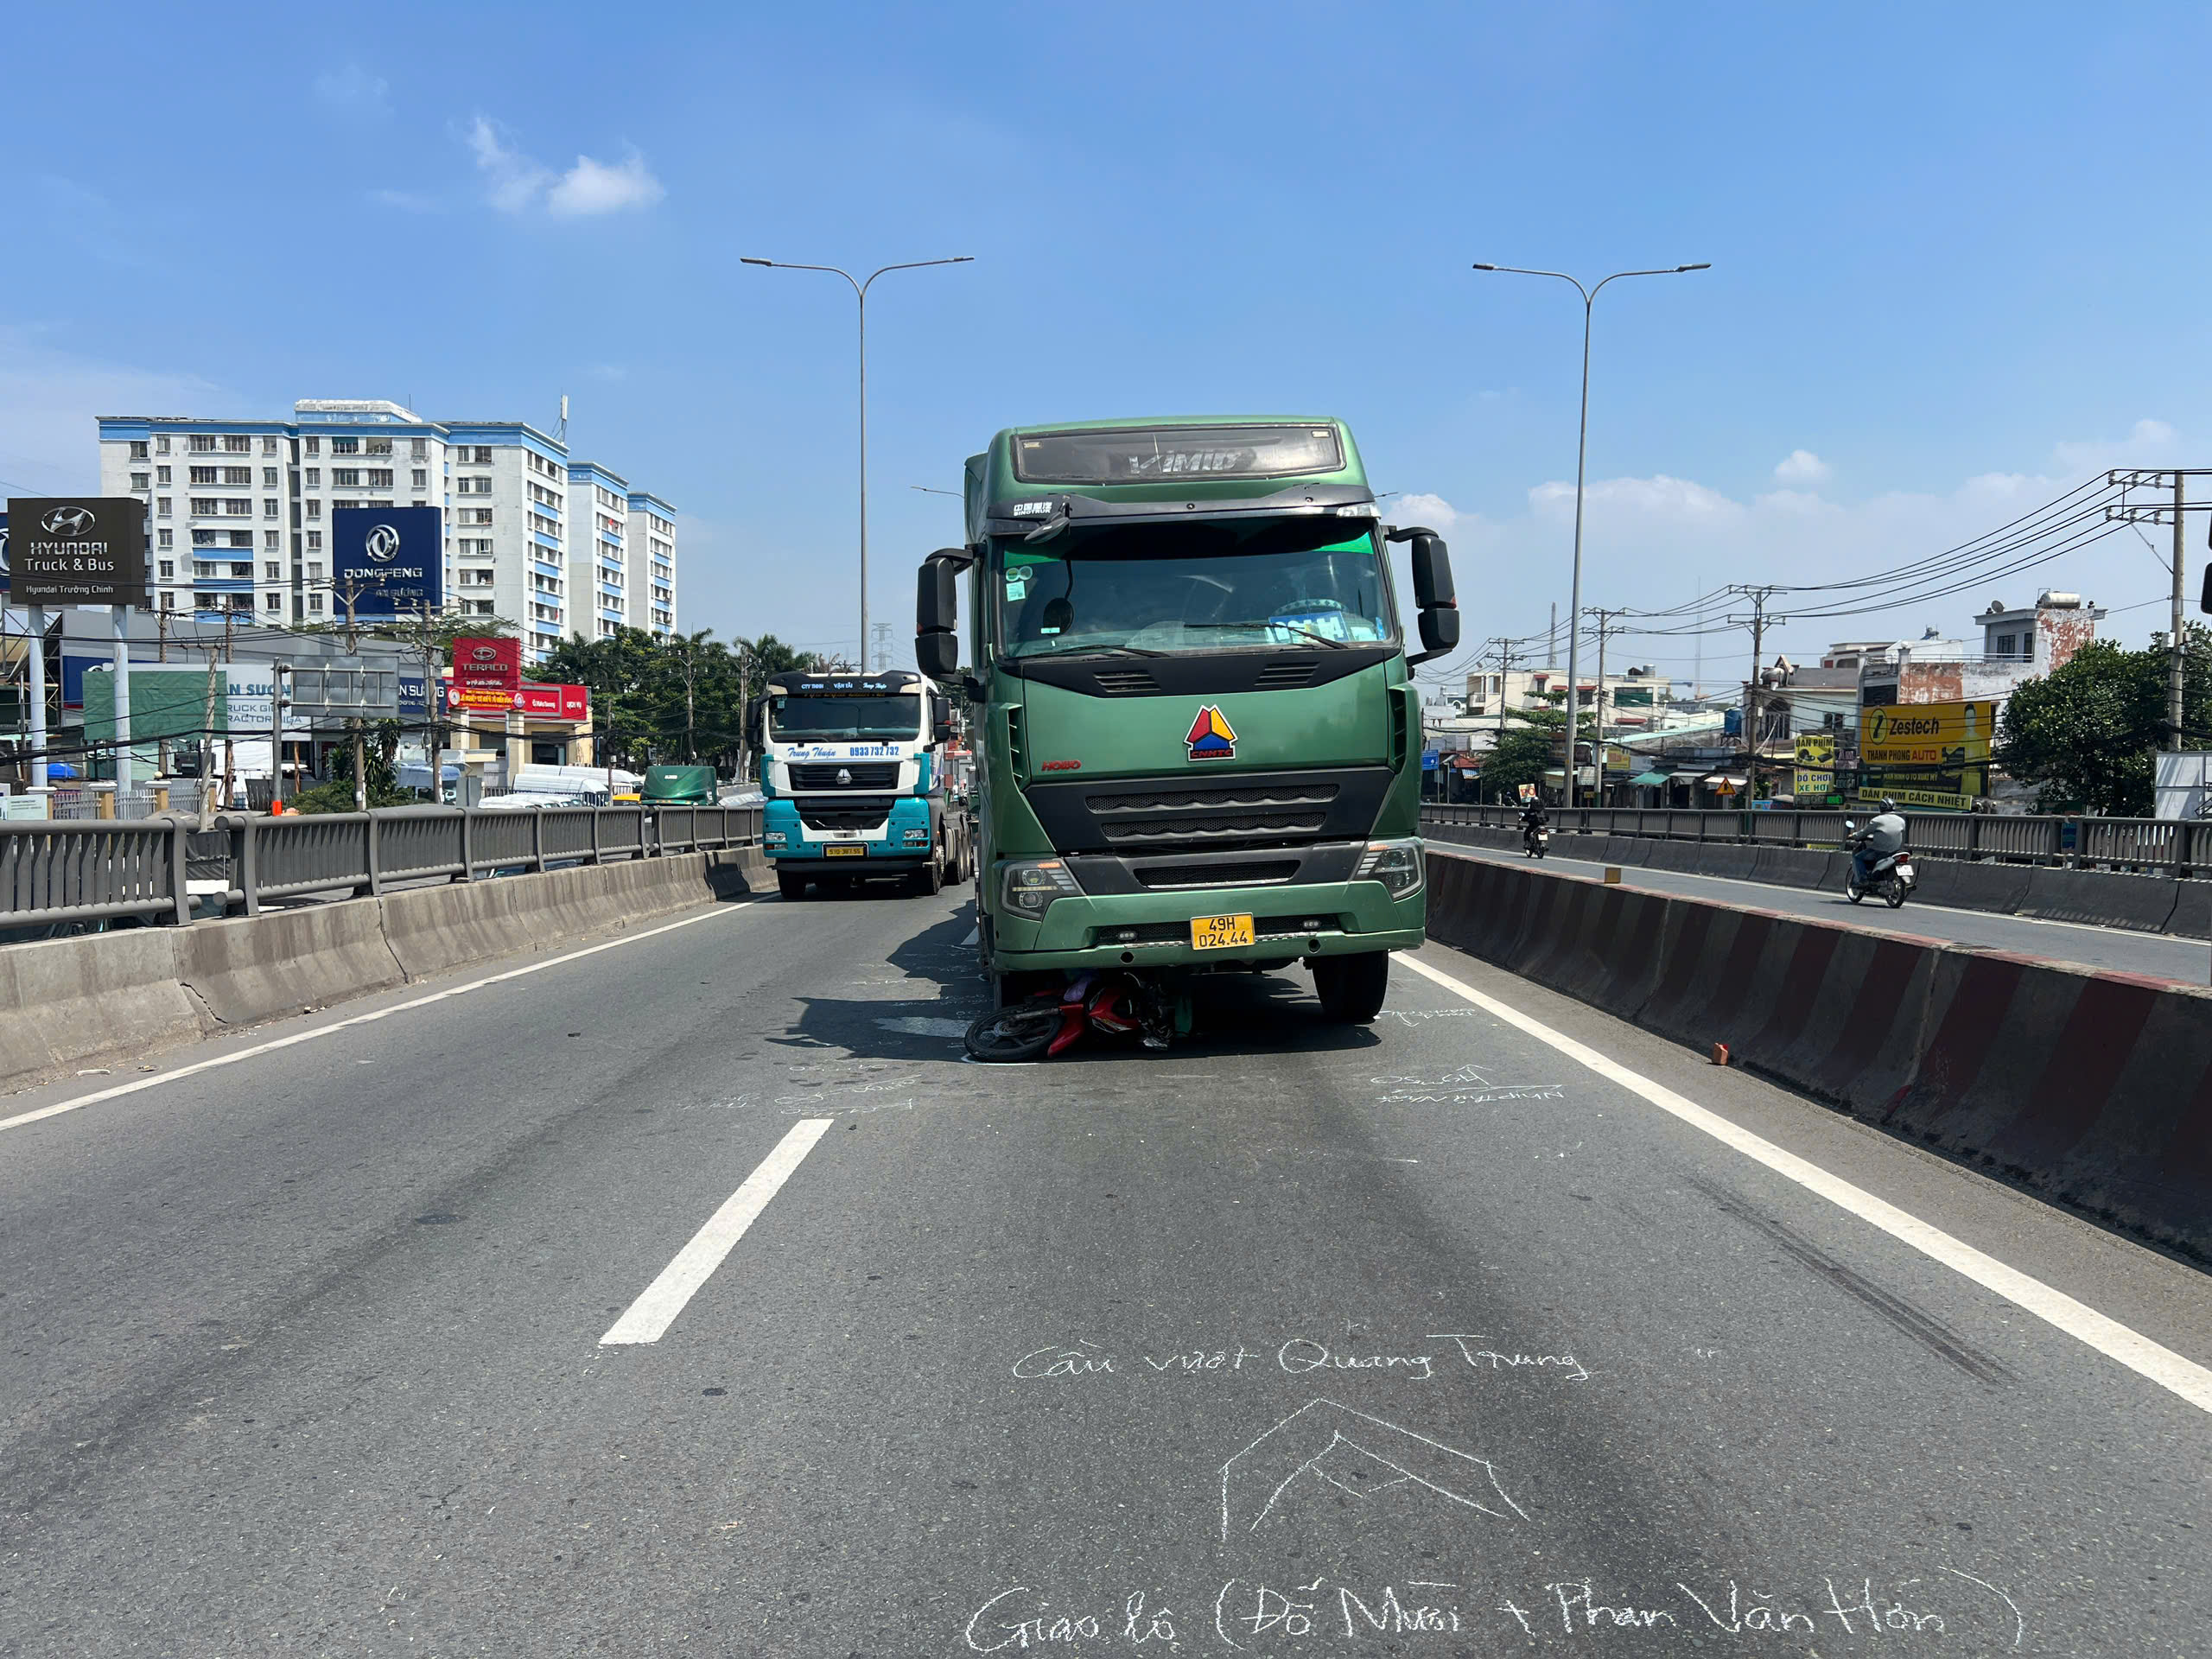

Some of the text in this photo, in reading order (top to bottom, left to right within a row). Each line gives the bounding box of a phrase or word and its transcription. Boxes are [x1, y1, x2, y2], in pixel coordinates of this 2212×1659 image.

[30, 542, 108, 555] HYUNDAI
[24, 558, 114, 571] Truck & Bus
[344, 568, 423, 578] DONGFENG
[26, 585, 57, 594] Hyundai
[92, 585, 114, 594] Chinh
[1889, 716, 1939, 734] Zestech
[787, 747, 810, 760] Trung
[850, 747, 869, 756] 0933
[870, 747, 884, 756] 732
[886, 746, 899, 756] 732
[1192, 749, 1232, 758] CNHTC
[1867, 750, 1937, 760] THANH PHONG AUTO
[1862, 788, 1880, 798] DÁN
[1882, 791, 1906, 800] PHIM
[1908, 791, 1935, 803] CÁCH
[1937, 795, 1967, 807] NHIỆT
[1210, 917, 1236, 931] 49H
[1199, 931, 1248, 947] 024.44
[1278, 1338, 1433, 1380] Quang
[1426, 1333, 1599, 1381] Trung
[965, 1586, 1100, 1652] Giao
[1545, 1576, 1678, 1635] Phan
[1676, 1579, 1815, 1633] Văn
